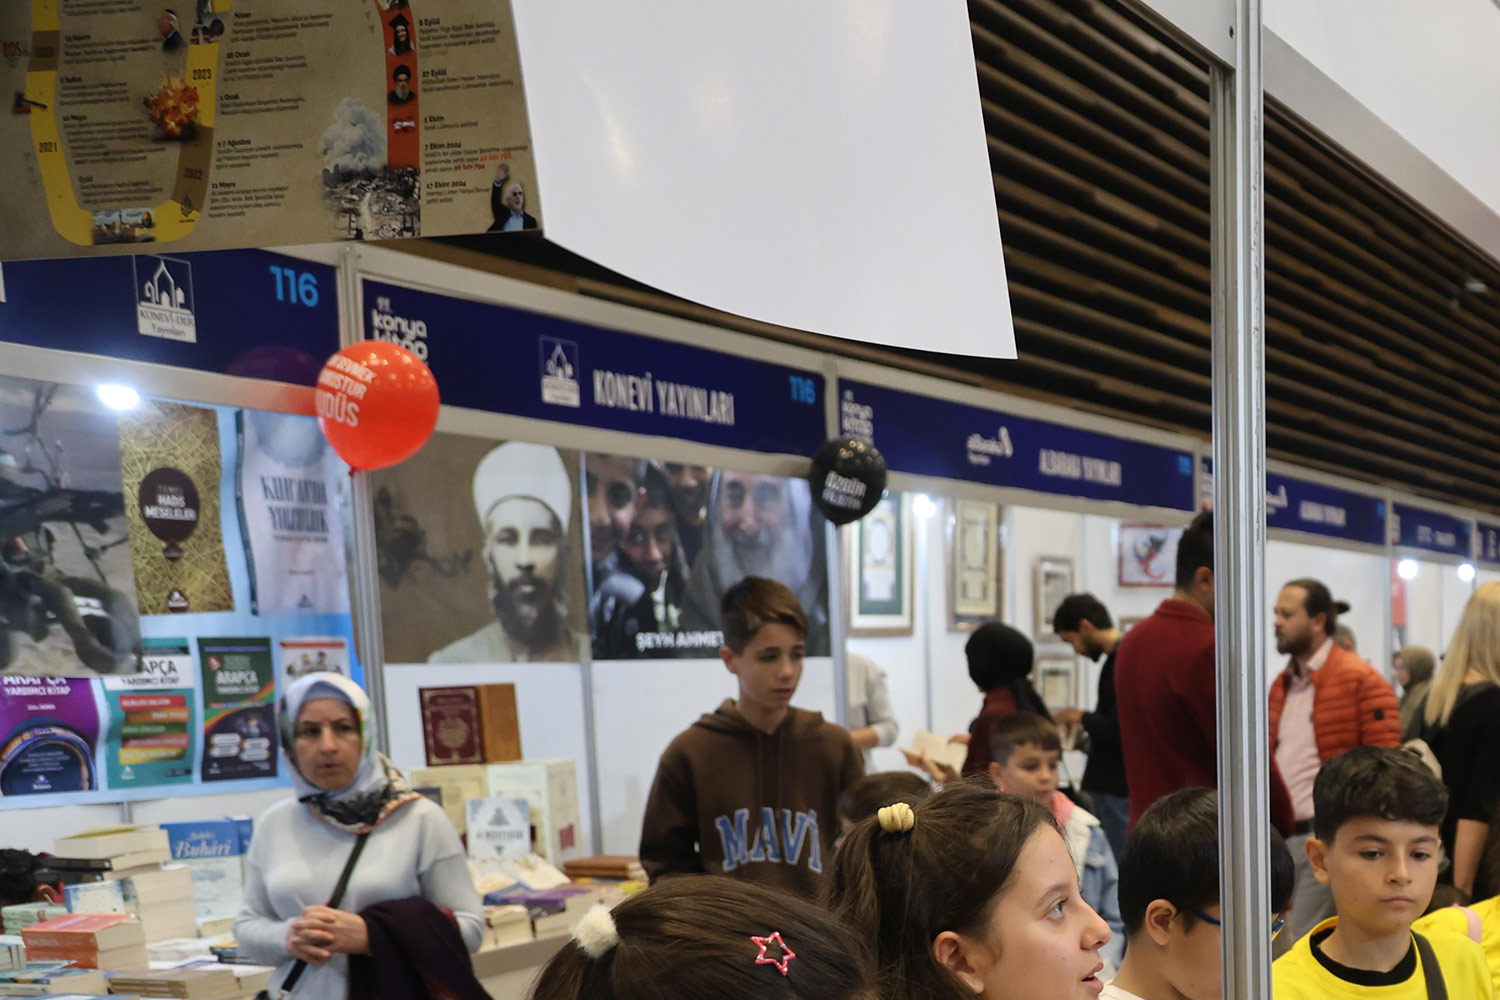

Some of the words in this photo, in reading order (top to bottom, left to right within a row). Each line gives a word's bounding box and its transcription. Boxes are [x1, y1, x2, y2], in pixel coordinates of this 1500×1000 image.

[270, 265, 319, 308] 116
[372, 309, 427, 339] konya
[593, 369, 653, 413] KONEVİ
[656, 380, 735, 426] YAYINLARI
[715, 807, 822, 873] MAVİ
